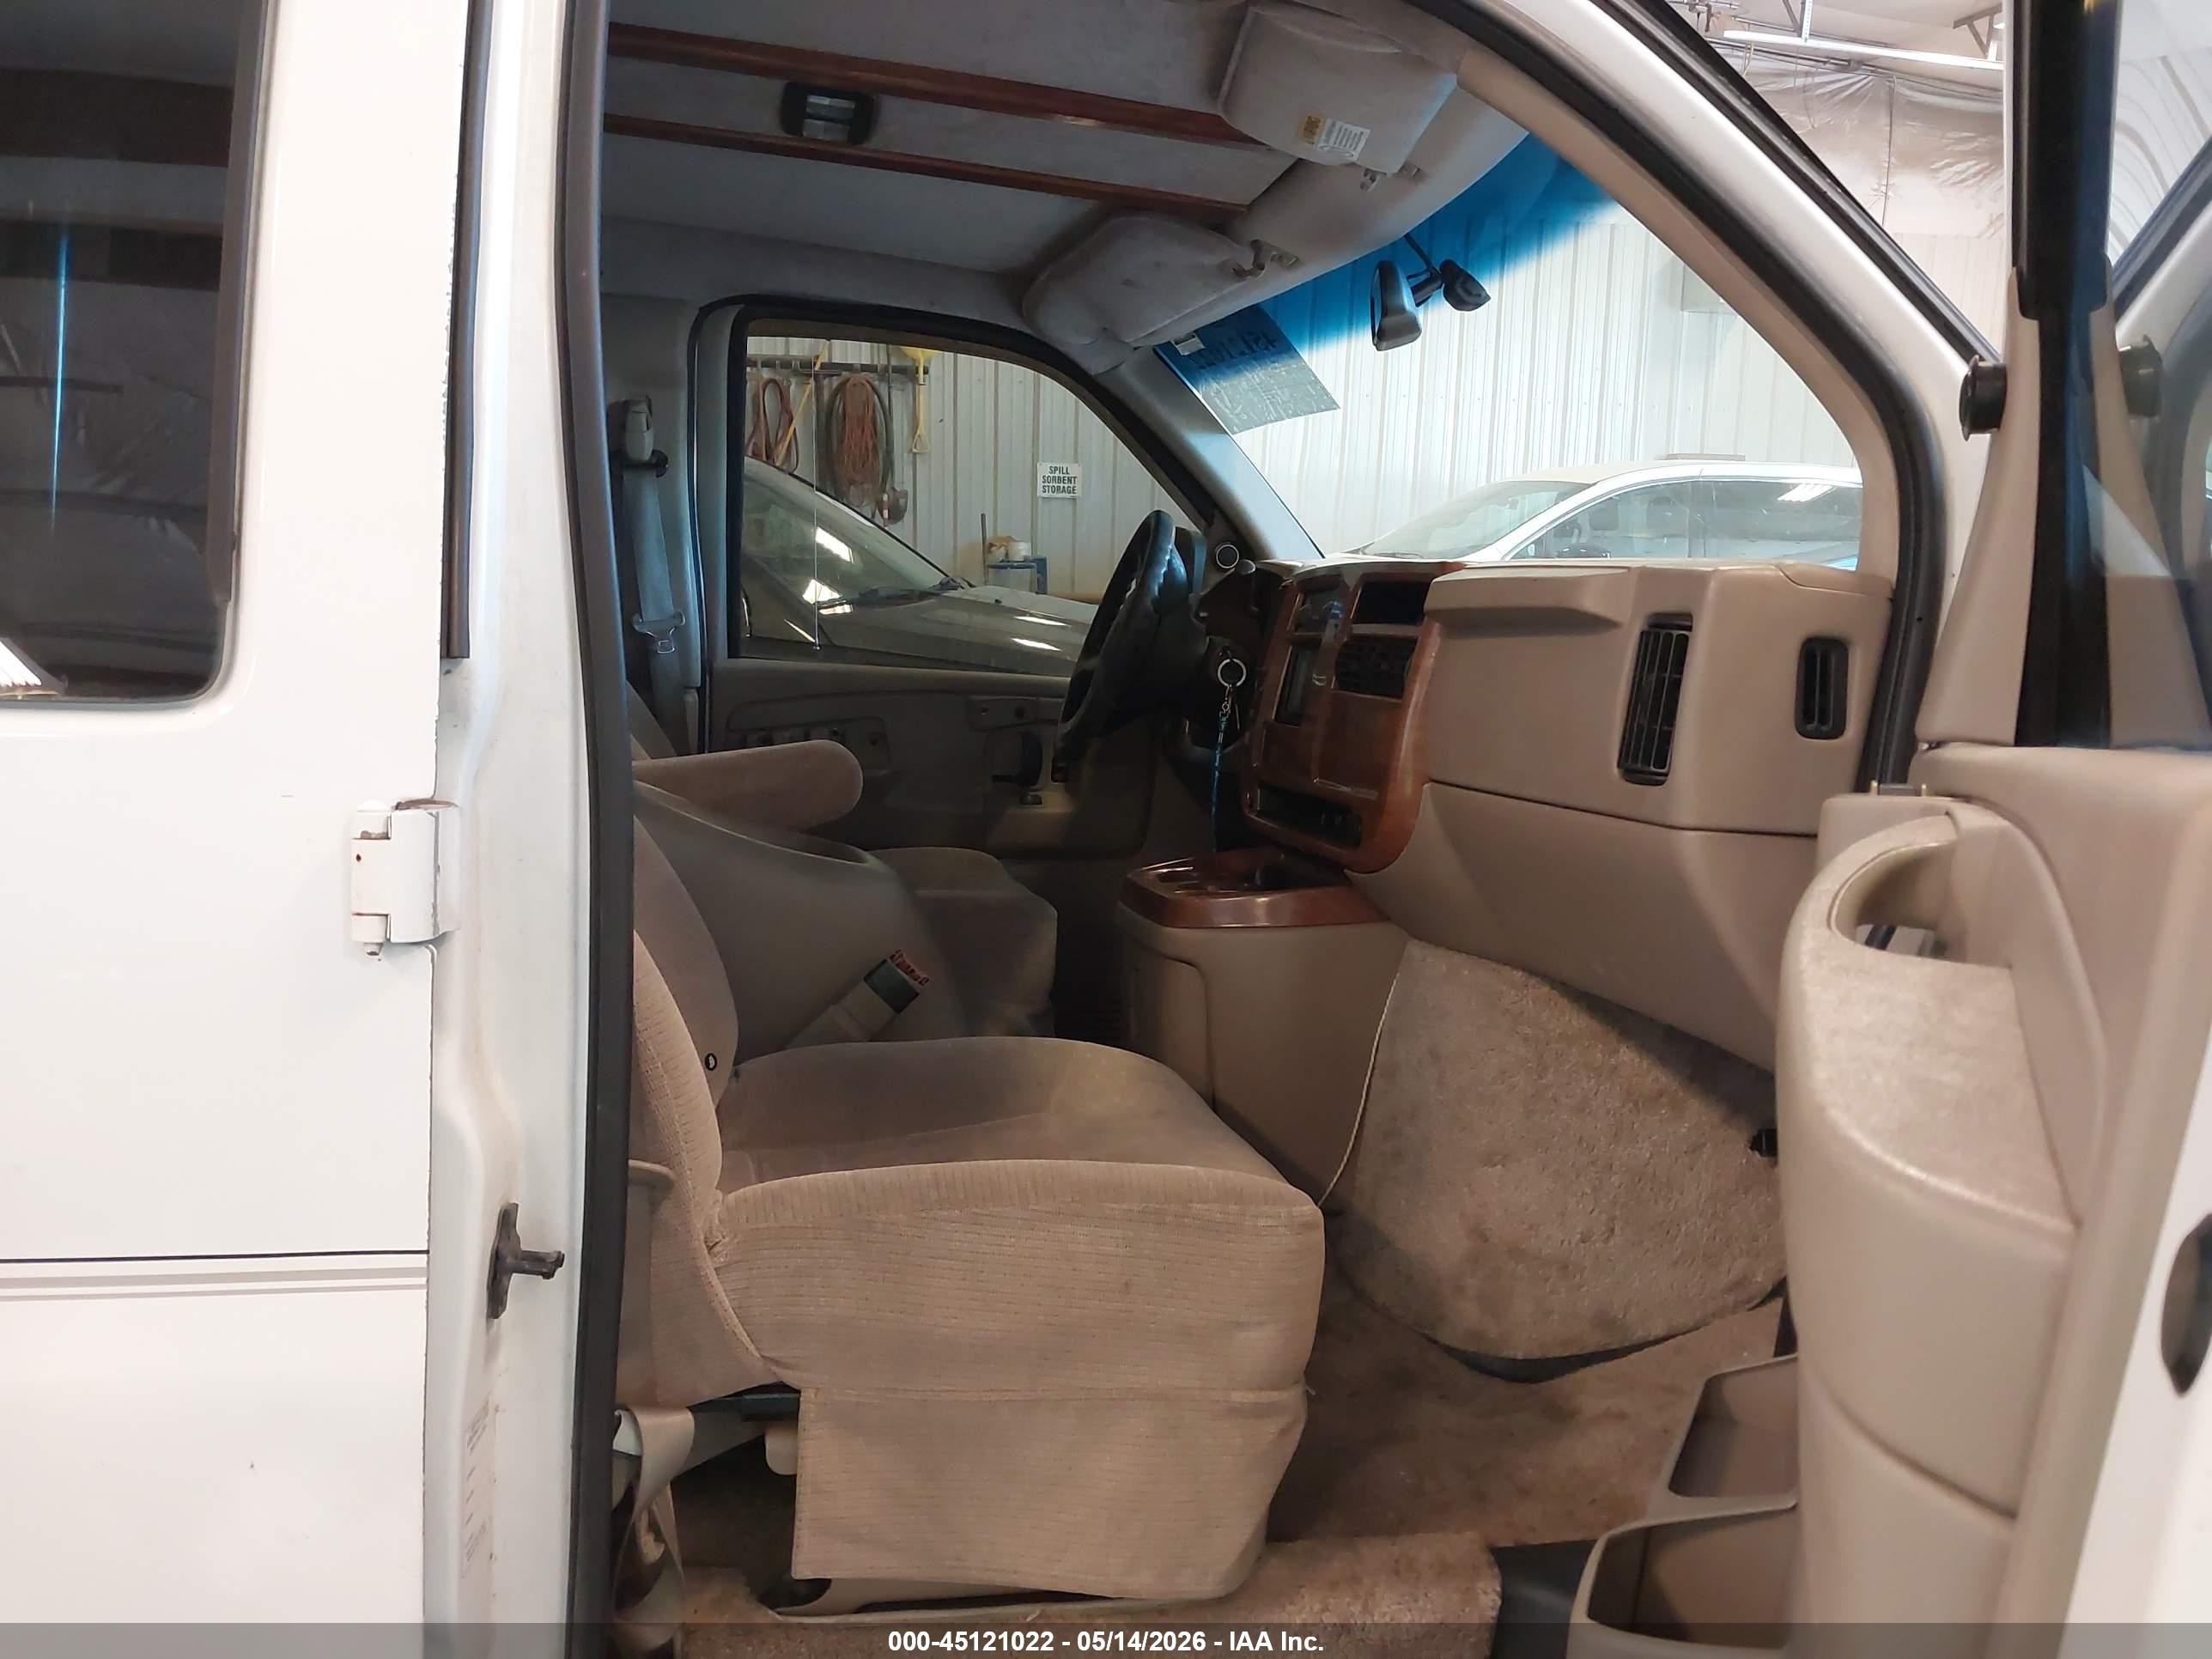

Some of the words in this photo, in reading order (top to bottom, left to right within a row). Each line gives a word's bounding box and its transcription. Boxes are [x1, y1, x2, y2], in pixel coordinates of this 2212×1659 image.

[1048, 465, 1070, 475] SPILL
[1042, 475, 1078, 484] SORBENT
[1042, 485, 1077, 495] STORAGE
